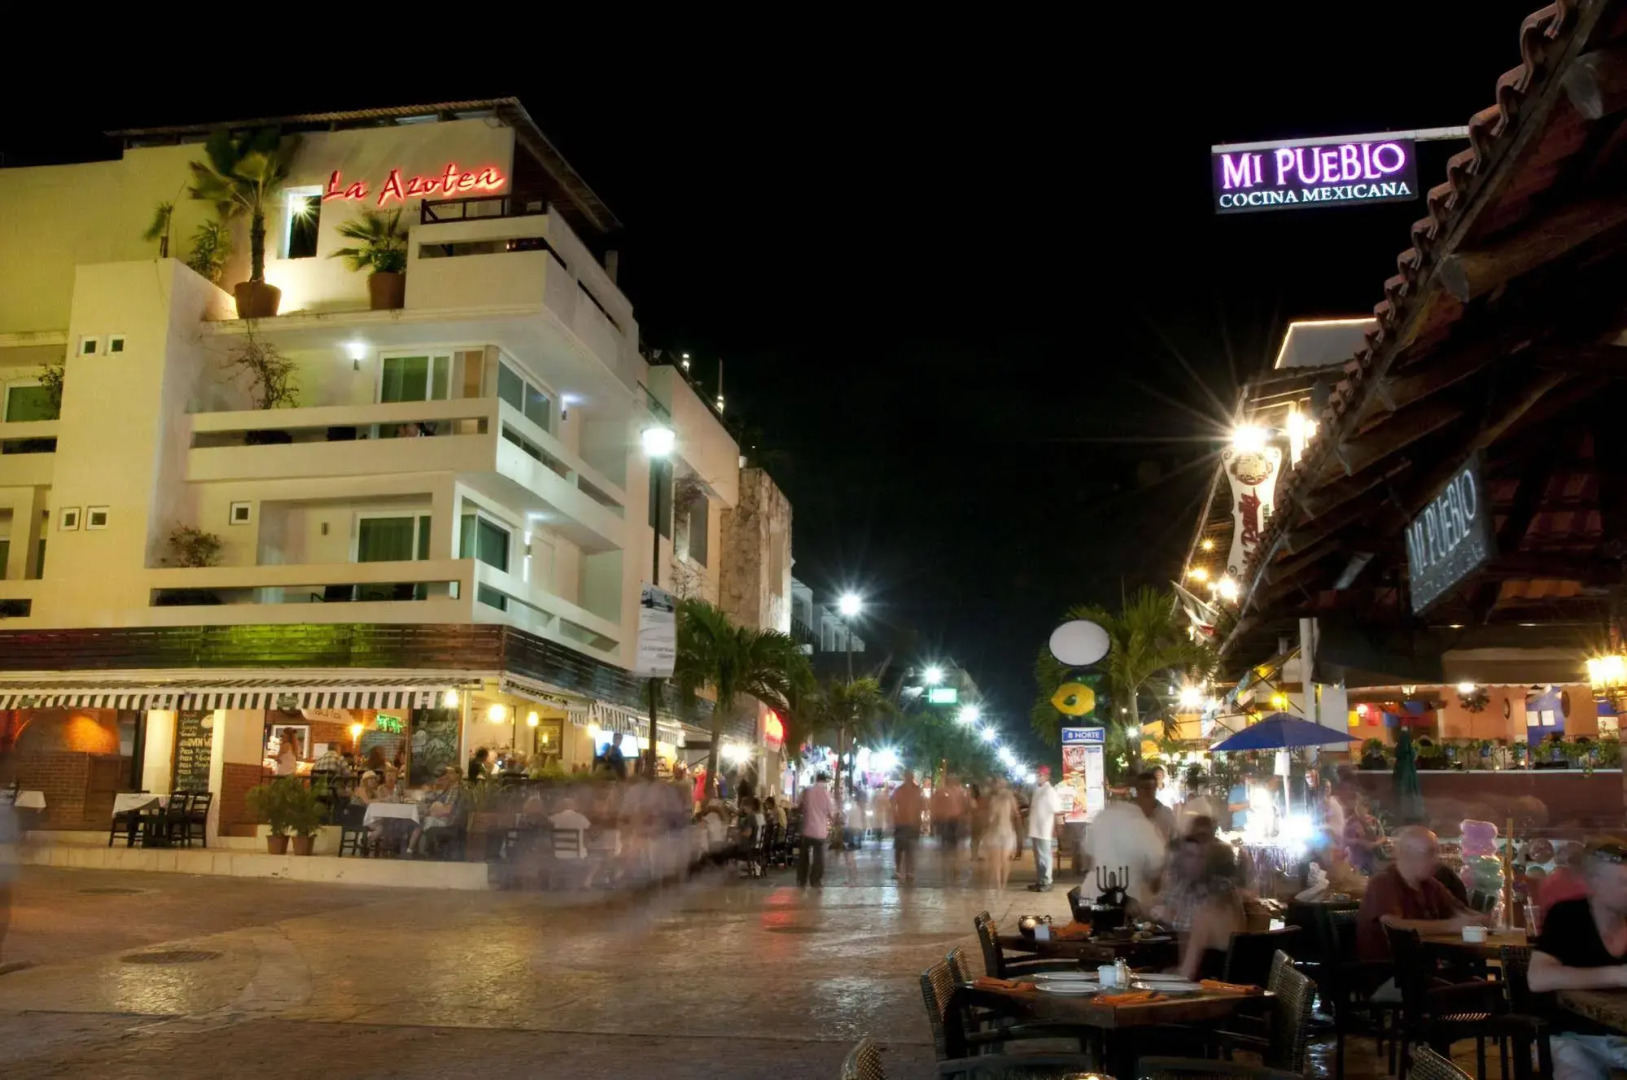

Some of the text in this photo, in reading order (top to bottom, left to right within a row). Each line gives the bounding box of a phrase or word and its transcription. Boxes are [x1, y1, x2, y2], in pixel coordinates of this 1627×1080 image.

[1221, 143, 1405, 189] MI PUEBLO
[323, 163, 503, 206] La Azotea
[1219, 181, 1412, 208] COCINA MEXICANA
[1067, 731, 1100, 739] 8 NORTE
